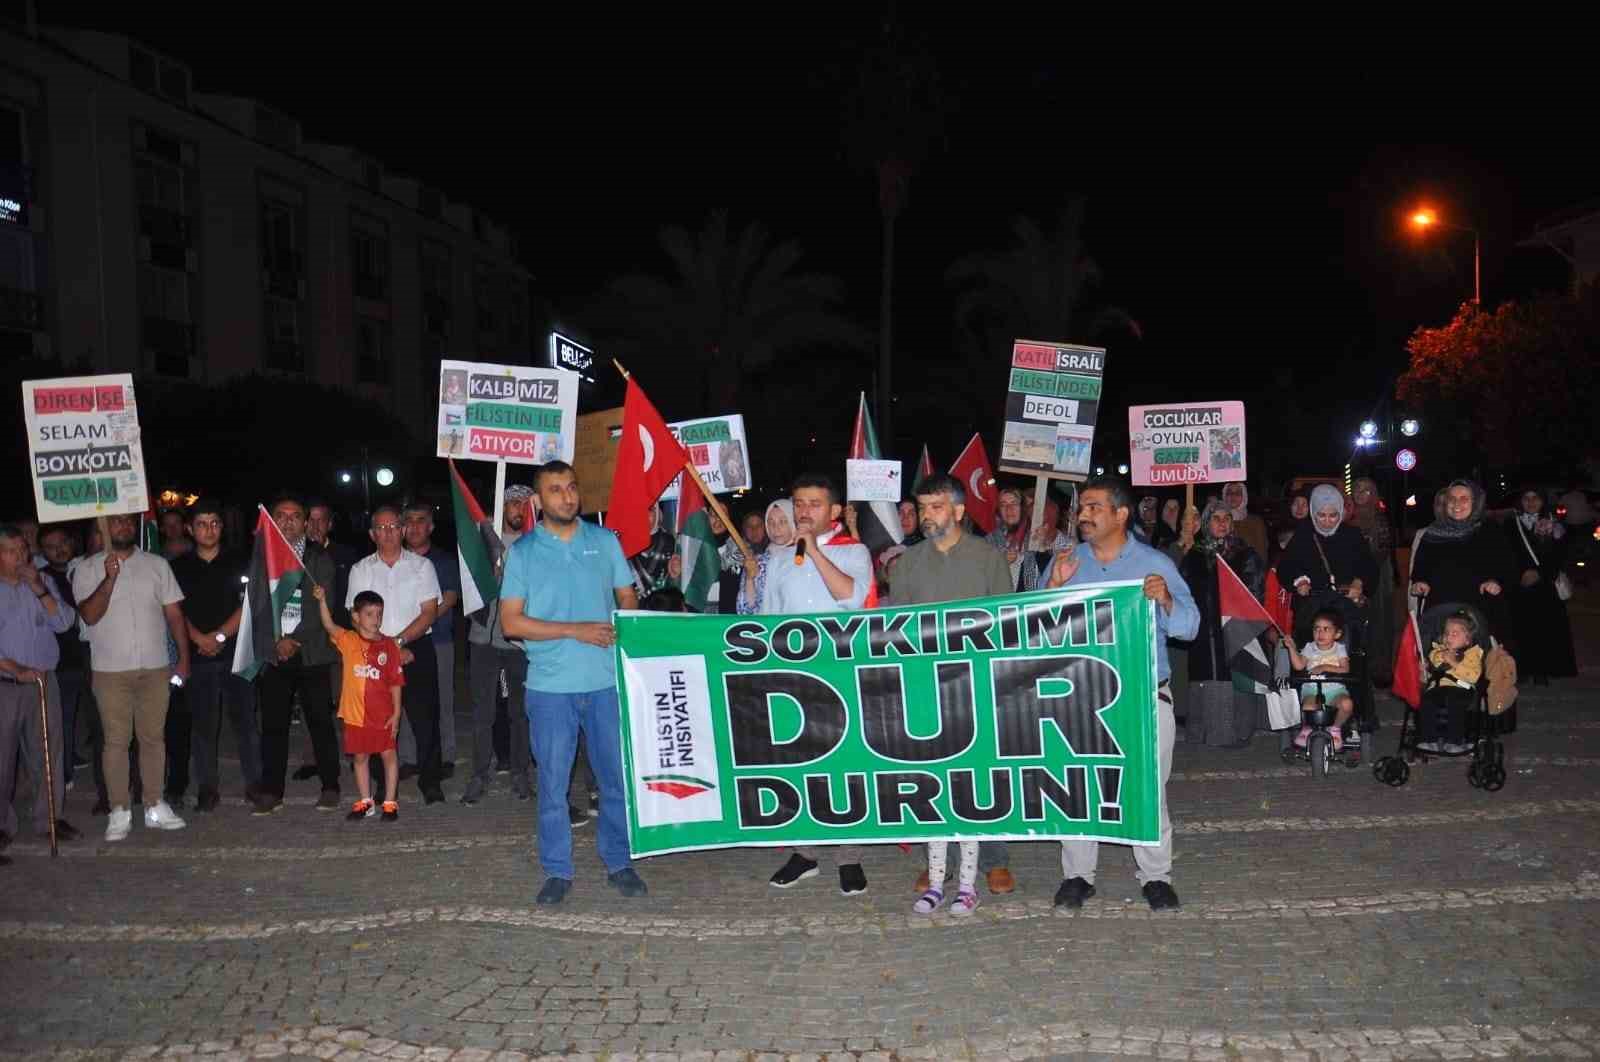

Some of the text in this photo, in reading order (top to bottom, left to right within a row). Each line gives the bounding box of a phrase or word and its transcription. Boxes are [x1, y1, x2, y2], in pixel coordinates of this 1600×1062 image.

[1025, 401, 1072, 418] DEFOL
[1144, 412, 1222, 429] ÇOCUKLAR
[40, 424, 107, 440] SELAM
[1152, 431, 1204, 445] OYUNA
[471, 434, 535, 454] ATIYOR
[36, 451, 131, 473] BOYKOTA
[723, 599, 1115, 663] SOYKIRIMI
[722, 654, 1125, 768] DUR
[735, 765, 1123, 829] DURUN!
